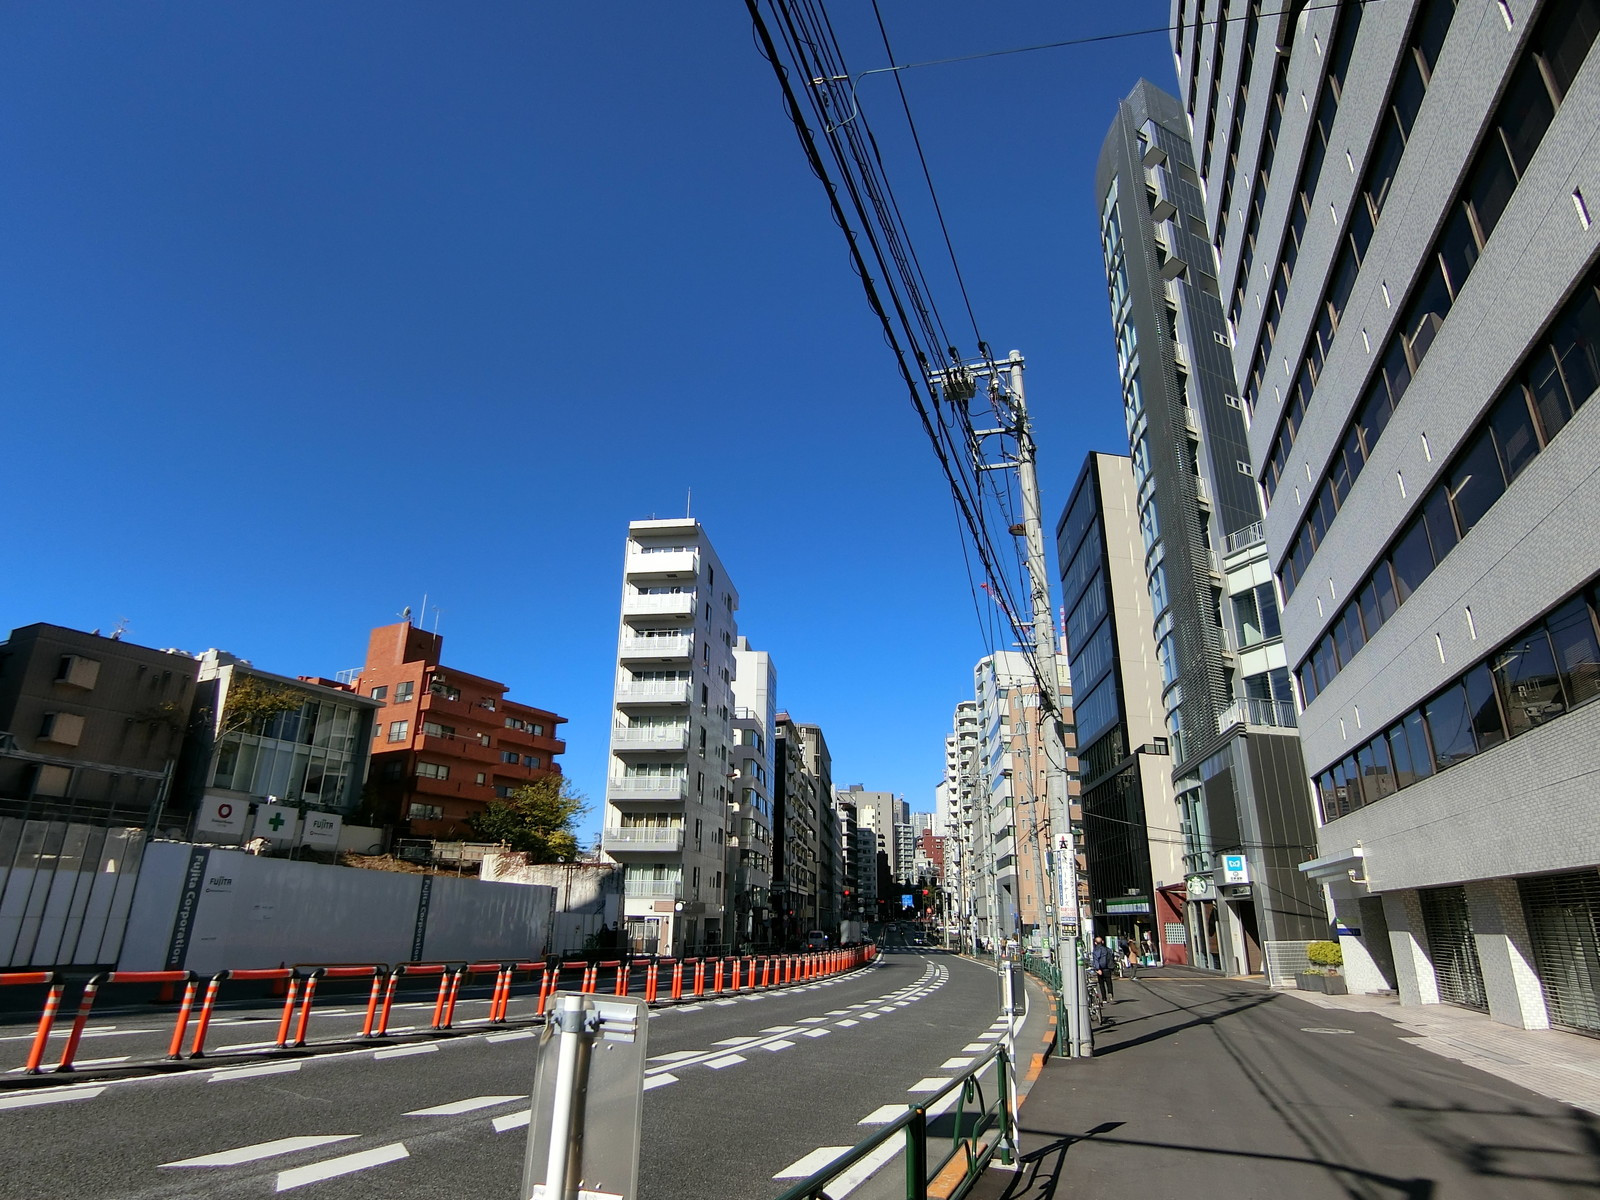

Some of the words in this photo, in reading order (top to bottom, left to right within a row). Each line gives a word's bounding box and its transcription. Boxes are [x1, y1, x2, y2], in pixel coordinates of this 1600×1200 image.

[313, 819, 334, 830] FUJITA
[189, 855, 205, 888] Fujita
[209, 876, 232, 886] FUJITA
[172, 889, 196, 963] Corporation
[412, 906, 427, 961] Corporation
